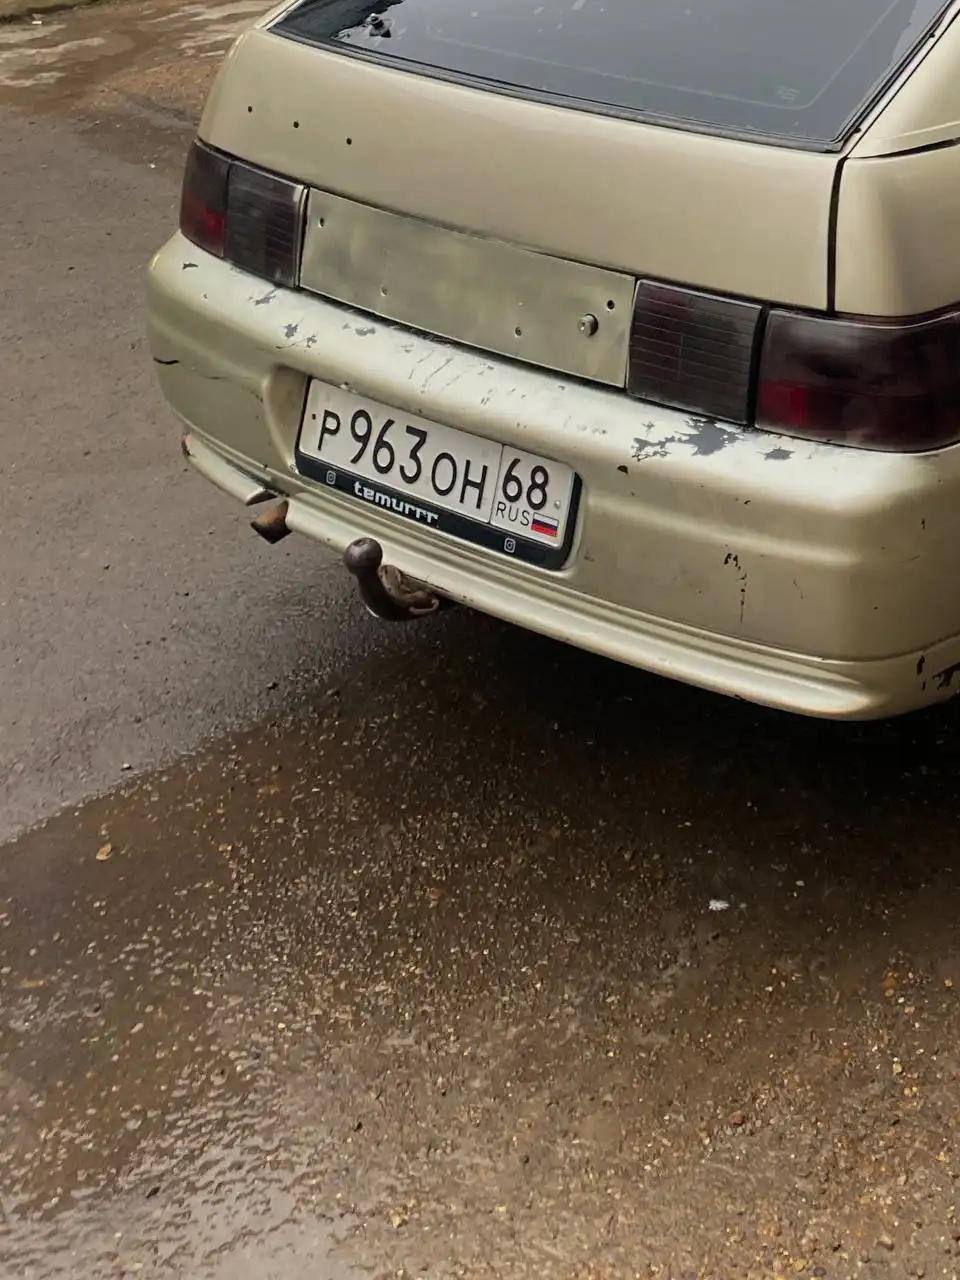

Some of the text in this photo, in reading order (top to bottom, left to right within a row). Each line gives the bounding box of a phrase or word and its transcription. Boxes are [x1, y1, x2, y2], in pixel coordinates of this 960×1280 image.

[317, 409, 549, 510] Р963ОН 68
[496, 502, 530, 526] RUS
